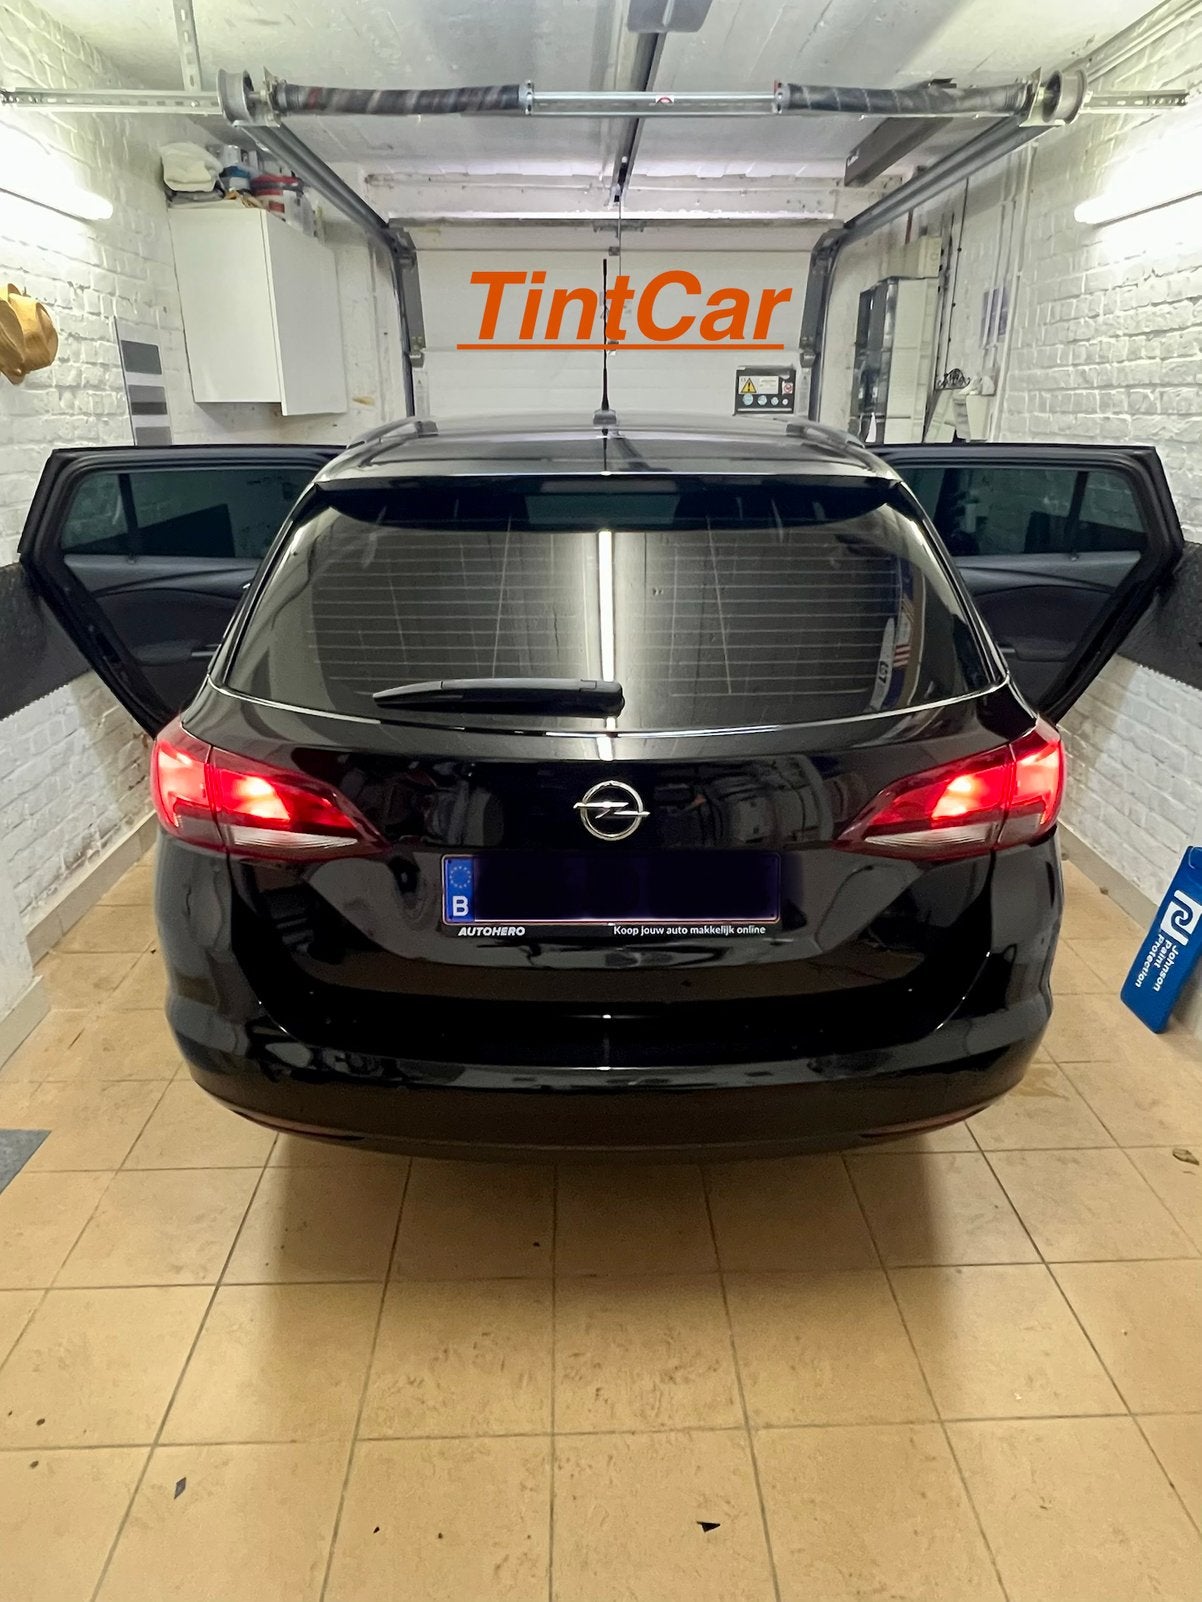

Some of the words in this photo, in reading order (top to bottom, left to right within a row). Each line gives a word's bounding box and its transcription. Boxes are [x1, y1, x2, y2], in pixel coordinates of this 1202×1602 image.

[452, 895, 469, 917] B
[458, 926, 526, 937] AUTOHERO
[613, 925, 639, 936] Koop
[641, 925, 665, 936] jouw
[667, 926, 688, 935] auto
[690, 924, 735, 936] makkelijk
[737, 924, 766, 935] online
[1135, 934, 1164, 988] Protection
[1153, 939, 1173, 968] Paint
[1153, 945, 1178, 992] Johnson
